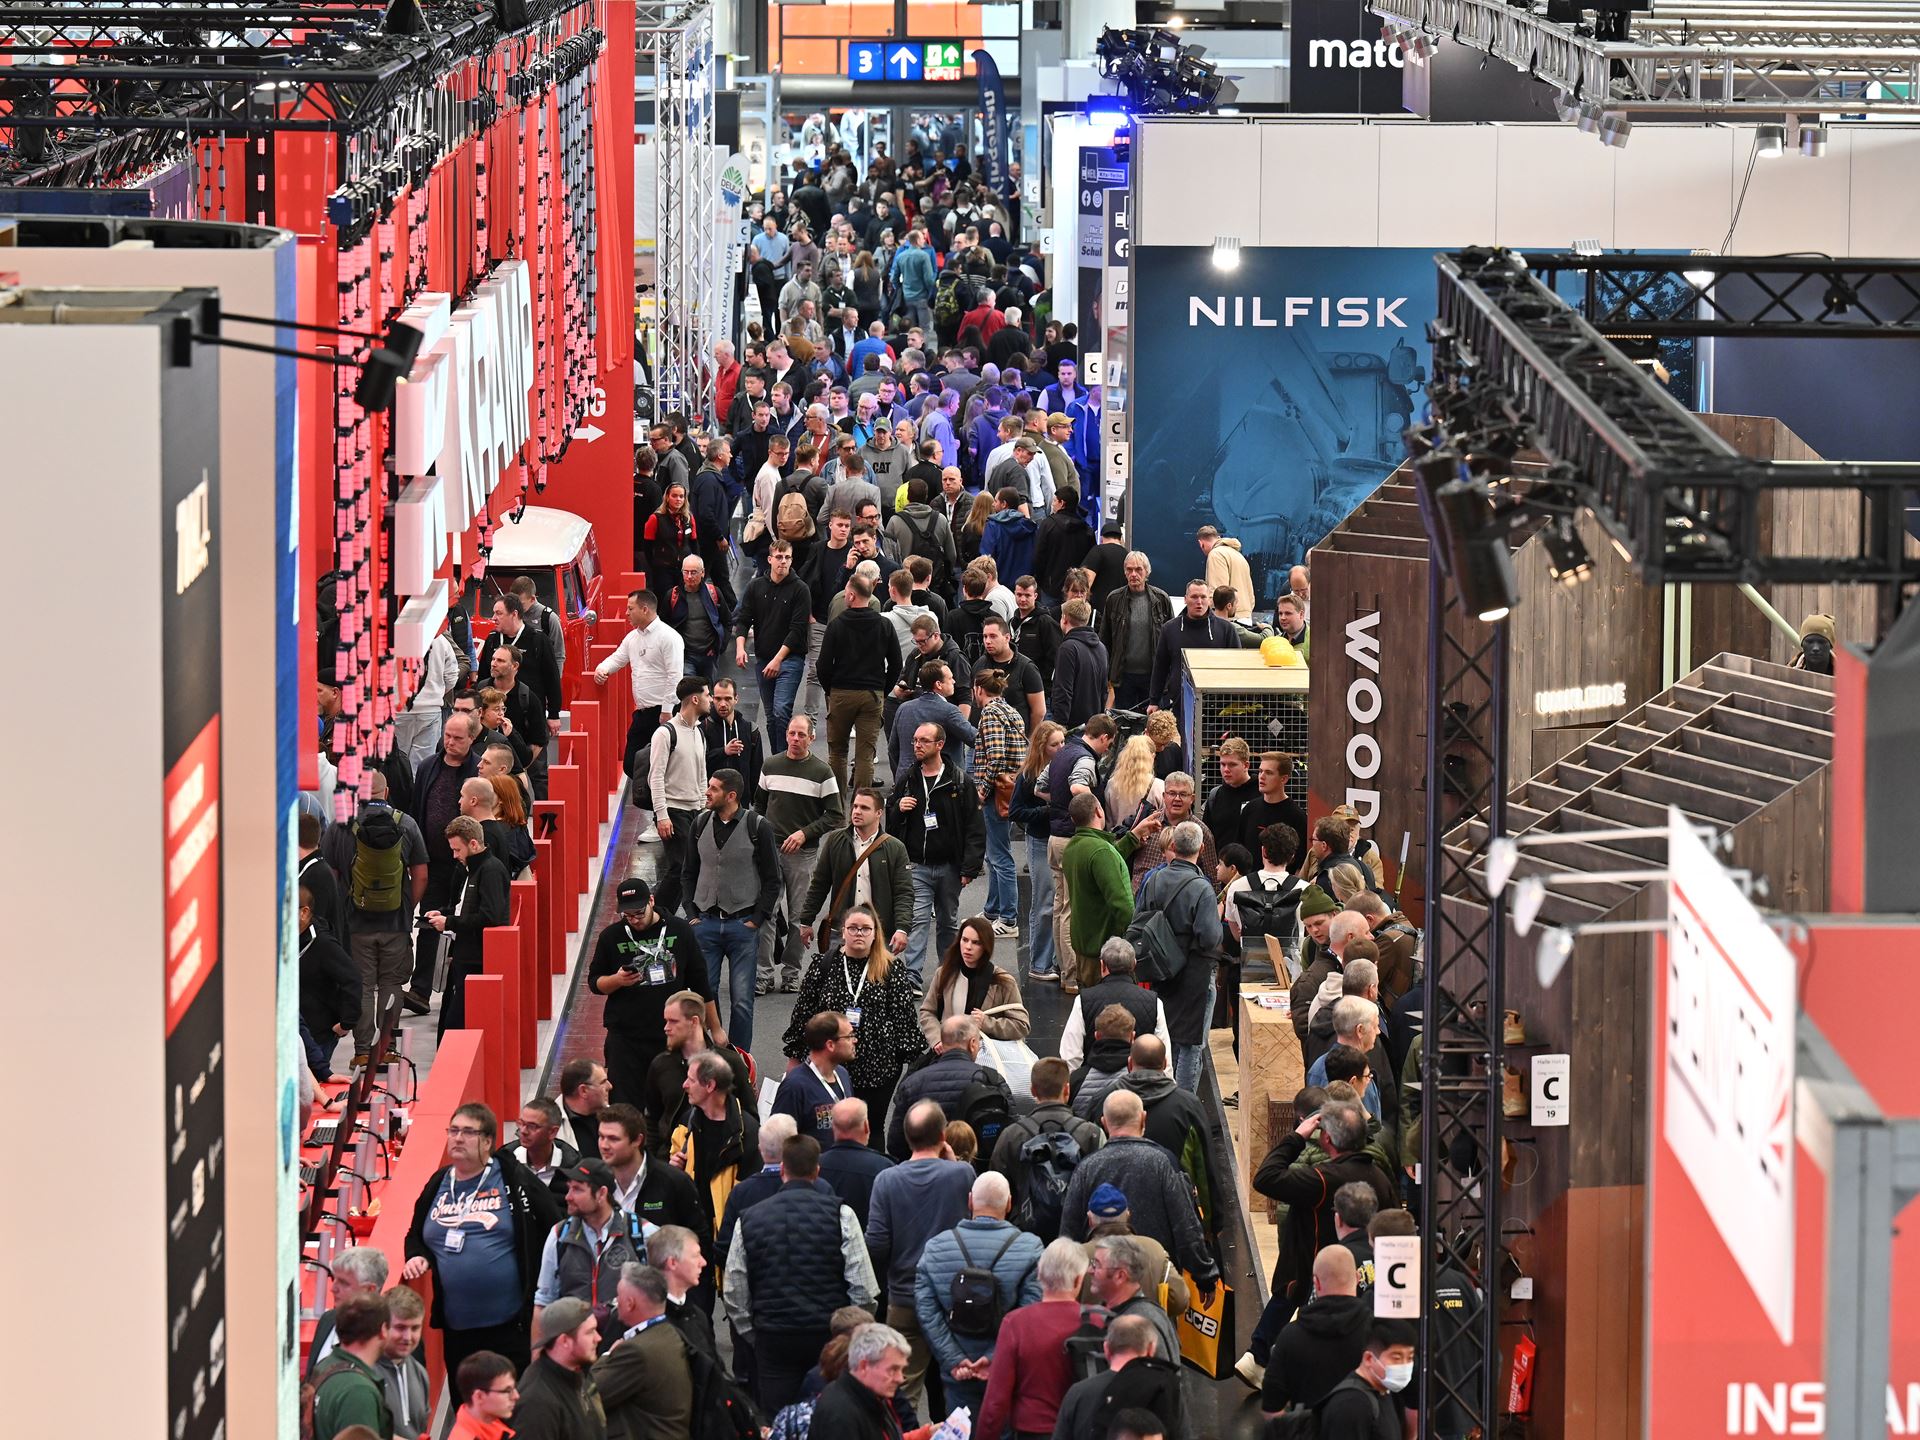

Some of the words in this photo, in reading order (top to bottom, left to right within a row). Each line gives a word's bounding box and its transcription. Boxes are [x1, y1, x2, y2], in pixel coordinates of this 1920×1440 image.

[858, 50, 873, 73] 3
[720, 243, 735, 340] WW.DEULA.DE
[1189, 296, 1409, 328] NILFISK
[1089, 362, 1098, 374] C
[1112, 422, 1121, 435] C
[872, 461, 891, 474] CAT
[1114, 453, 1123, 466] C
[1345, 611, 1382, 858] WOOD
[1543, 1077, 1560, 1101] C
[1546, 1110, 1556, 1118] 19
[1387, 1262, 1406, 1290] C
[1392, 1300, 1402, 1309] 18
[1186, 1309, 1218, 1338] JCB
